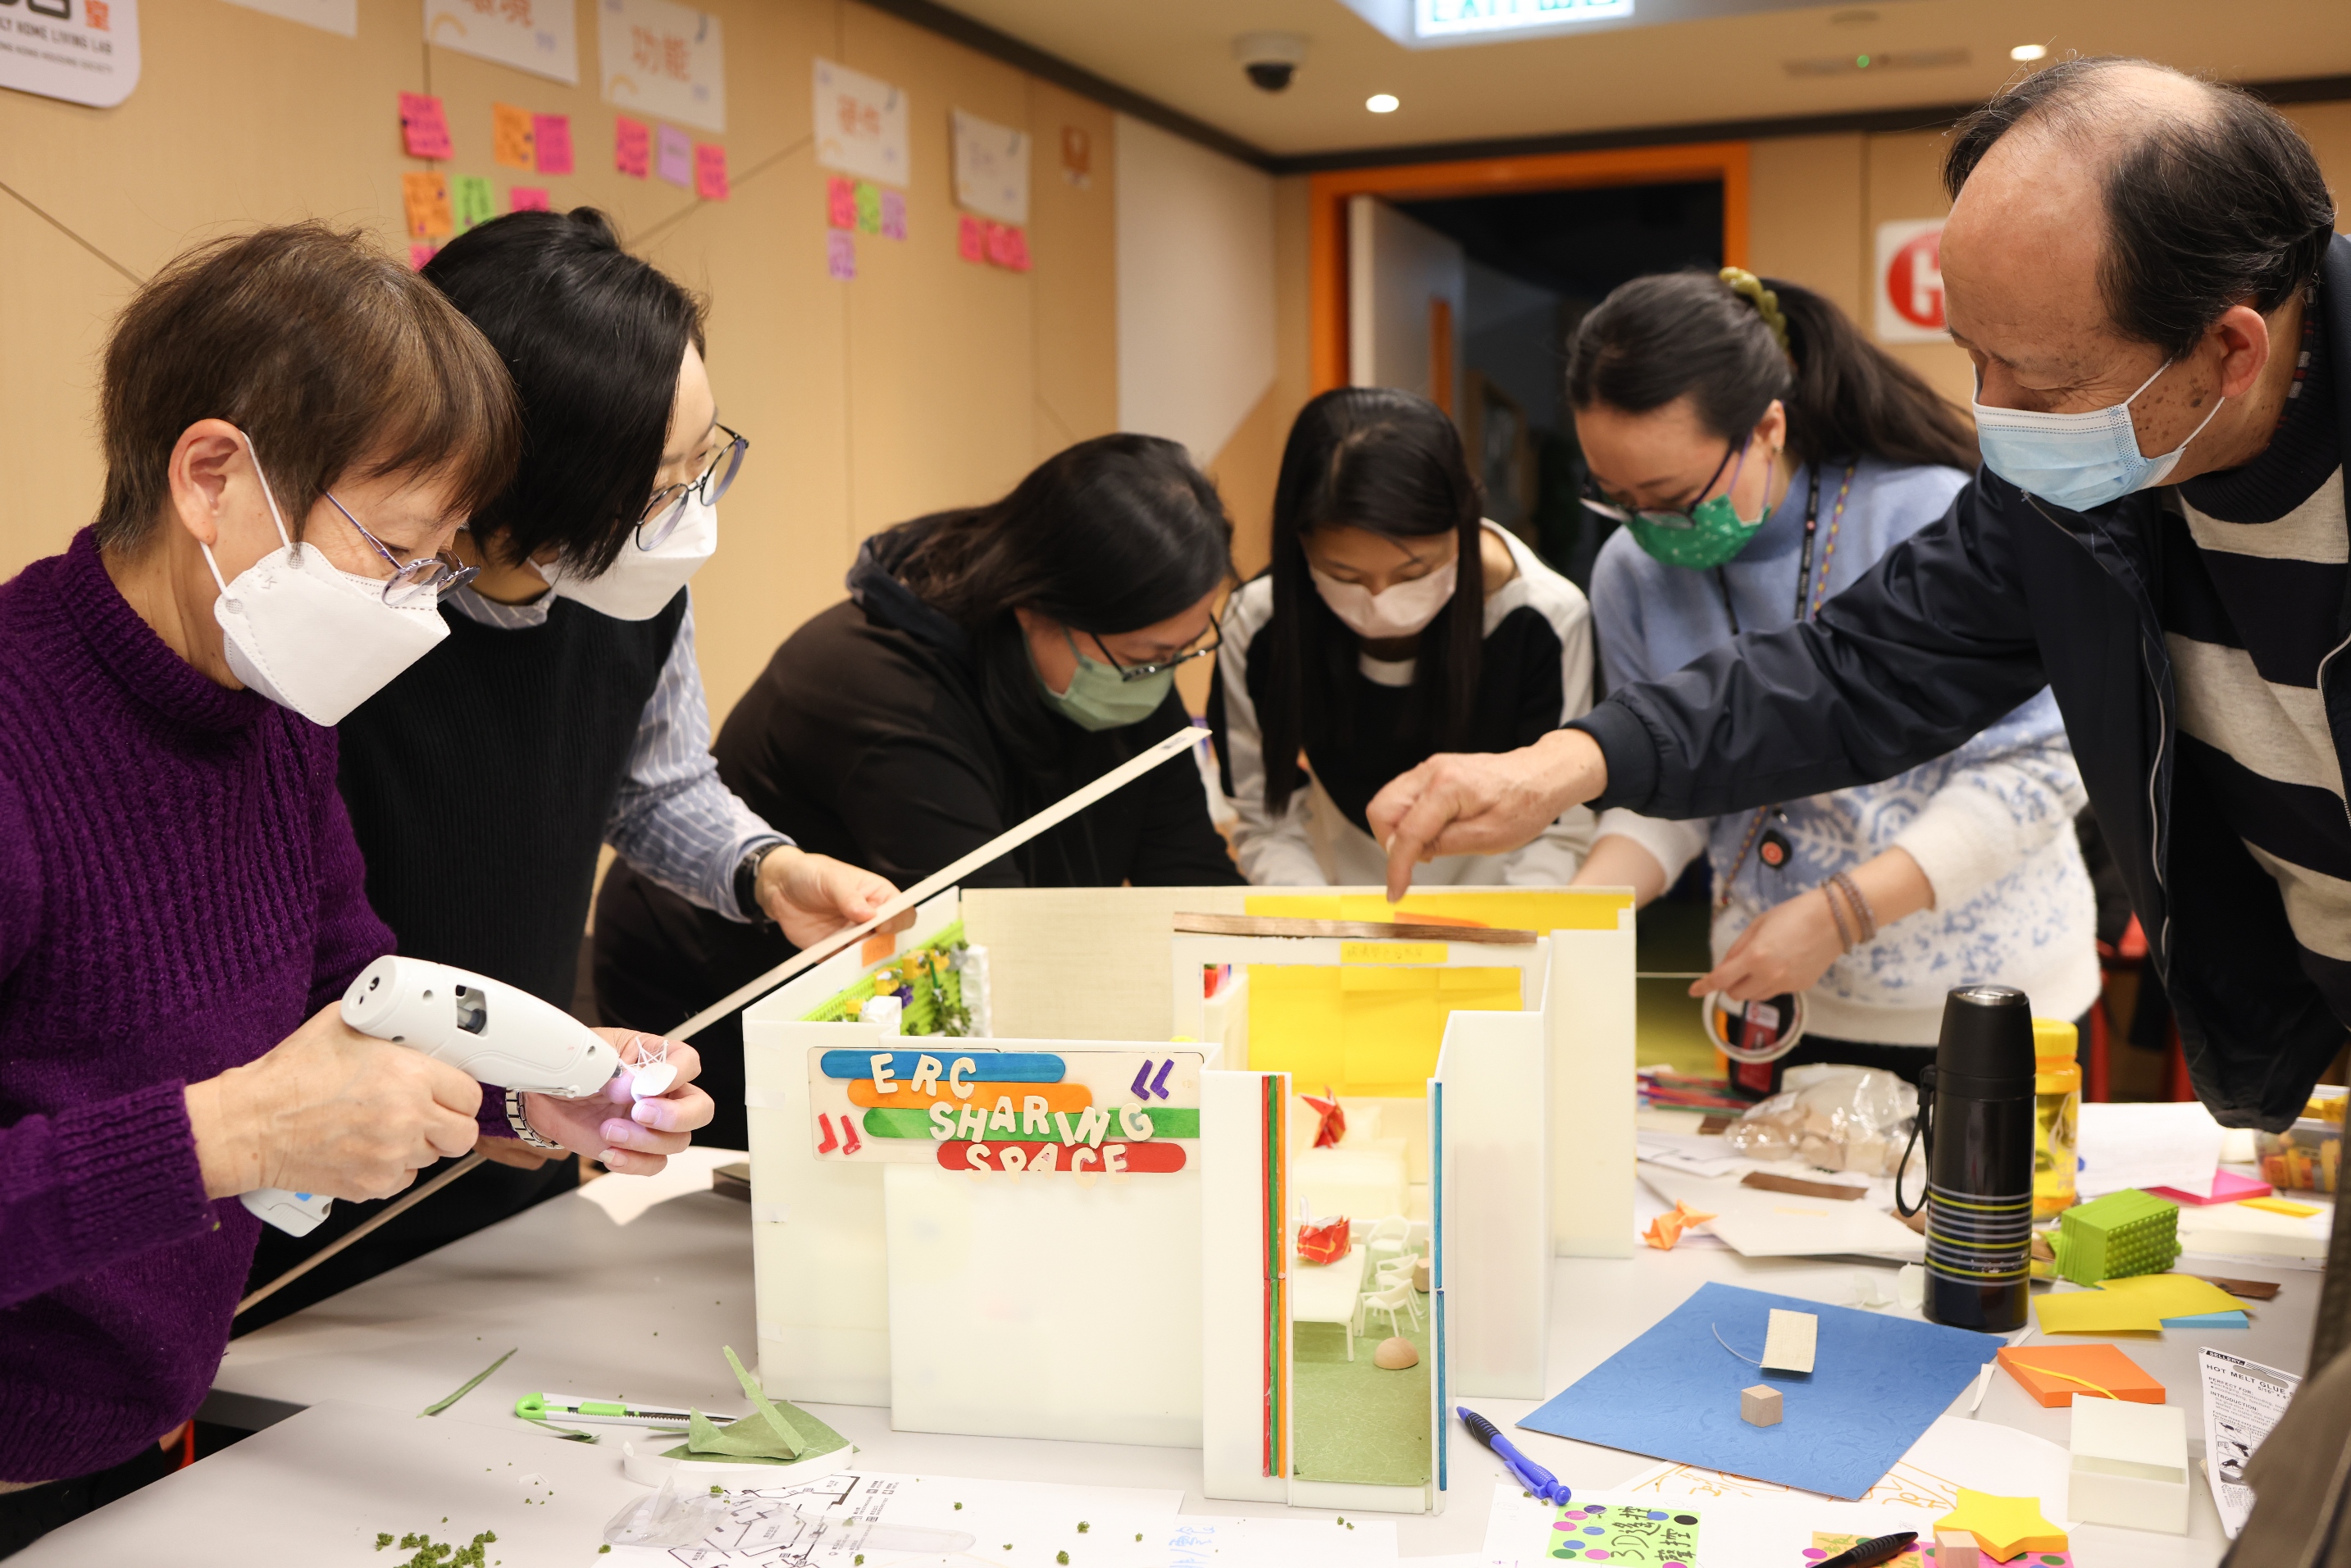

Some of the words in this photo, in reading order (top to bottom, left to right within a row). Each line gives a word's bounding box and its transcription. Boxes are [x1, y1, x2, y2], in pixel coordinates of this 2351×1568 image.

[870, 1052, 977, 1100] ERC
[929, 1095, 1154, 1150] SHARING
[964, 1142, 1131, 1189] SPACE
[2206, 1364, 2226, 1374] HOT
[2230, 1371, 2256, 1383] MELT
[2259, 1381, 2286, 1395] GLUE
[2208, 1376, 2237, 1389] PERFECT
[2239, 1386, 2254, 1396] FOR:
